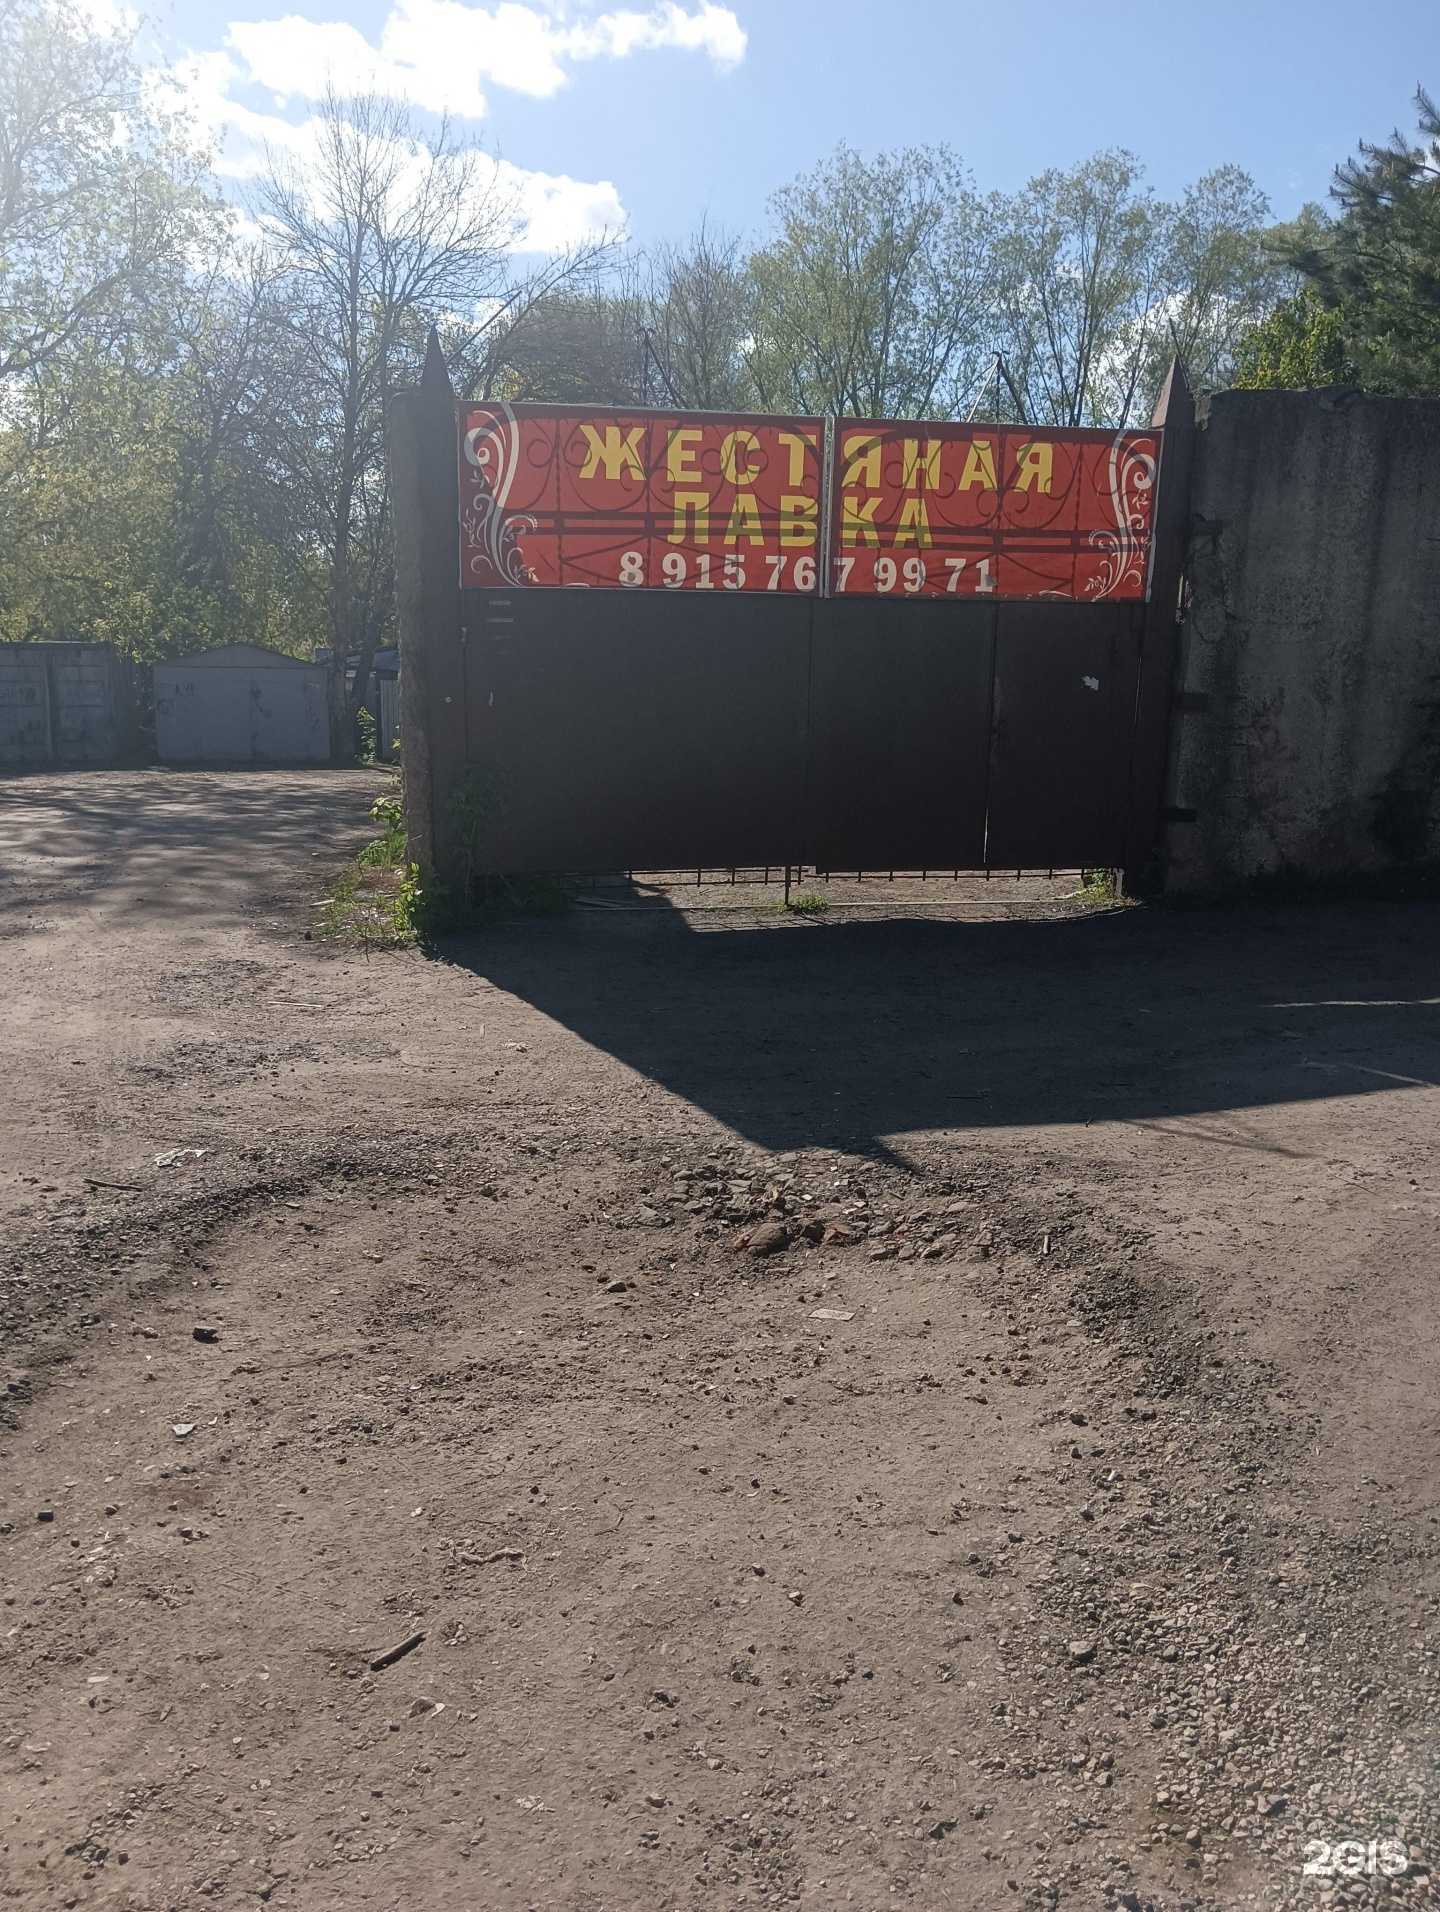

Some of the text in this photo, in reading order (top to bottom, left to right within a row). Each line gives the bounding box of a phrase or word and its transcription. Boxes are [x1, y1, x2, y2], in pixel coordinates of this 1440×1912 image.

[578, 424, 1053, 493] ЖЕСТЯНАЯ
[667, 491, 933, 549] ЛАВКА
[620, 551, 645, 588] 8
[662, 552, 745, 590] 915
[873, 557, 928, 593] 99
[944, 558, 995, 594] 71
